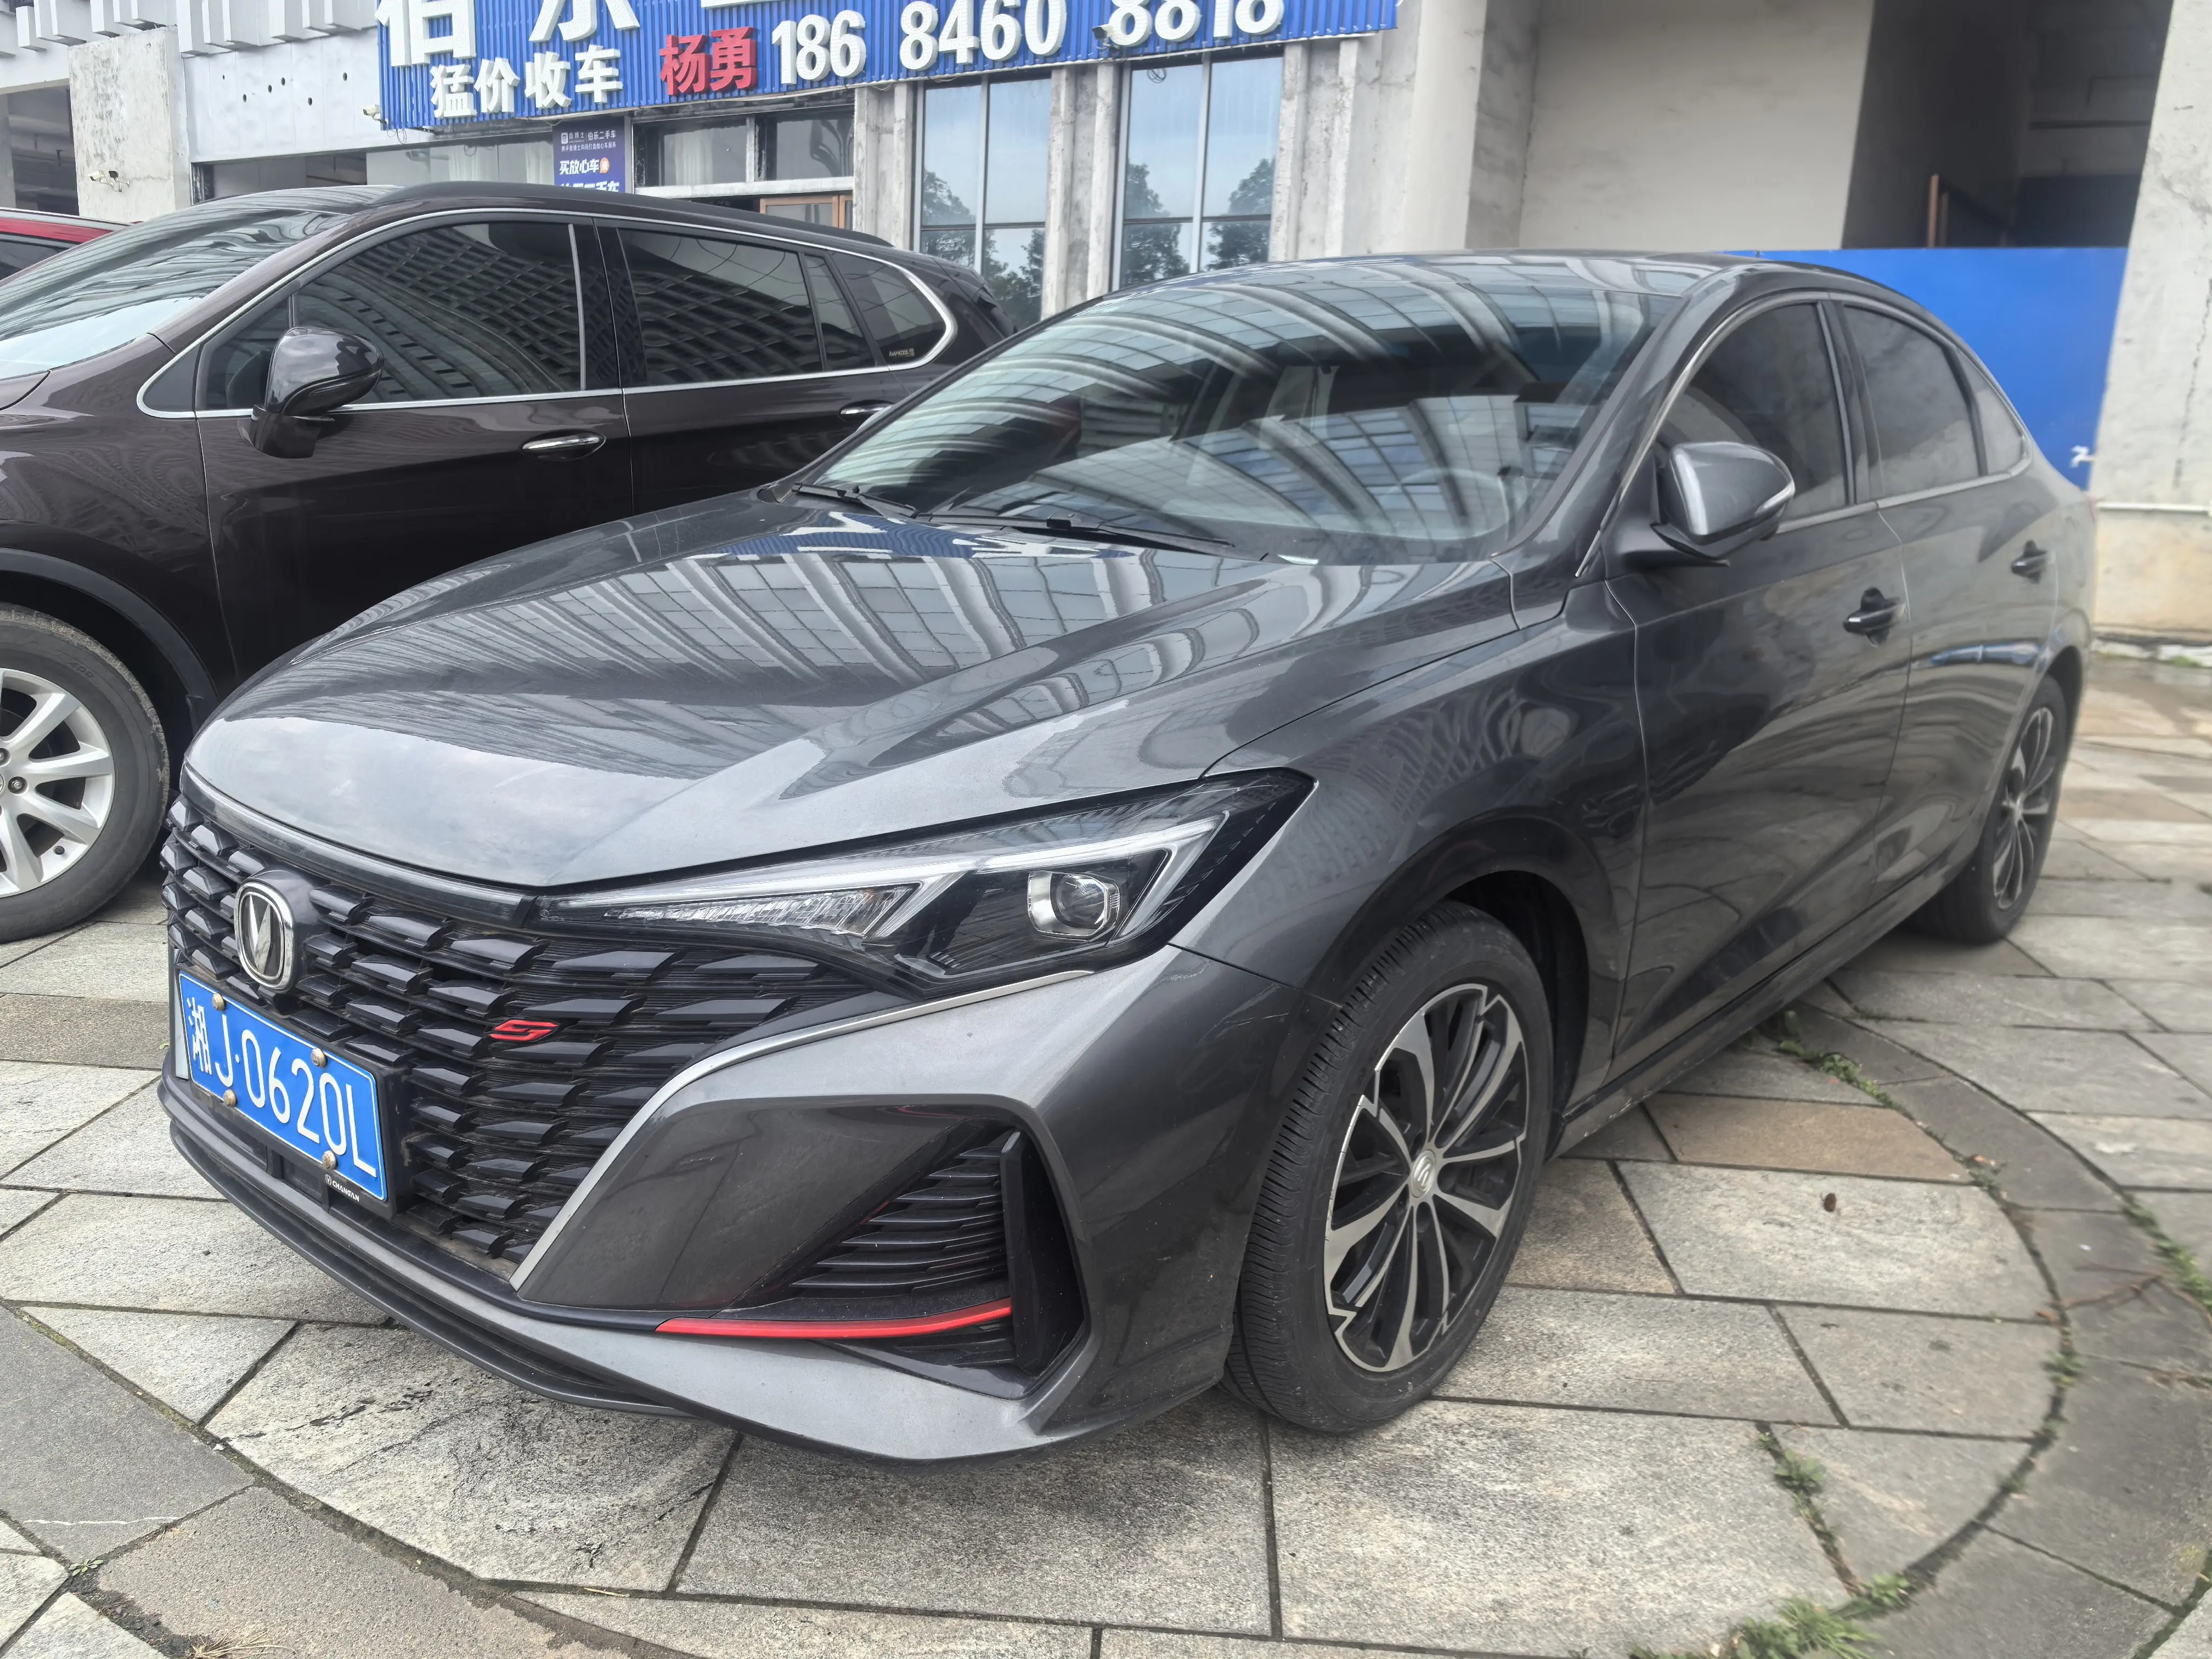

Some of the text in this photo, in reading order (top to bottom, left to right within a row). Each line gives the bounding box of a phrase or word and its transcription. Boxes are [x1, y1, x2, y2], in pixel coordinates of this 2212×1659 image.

[430, 45, 623, 118] 猛价收车
[659, 26, 756, 96] 杨勇
[772, 10, 866, 84] 186
[900, 0, 1067, 70] 8460
[559, 158, 599, 175] 买放心车
[332, 1180, 360, 1202] CHANGAN
